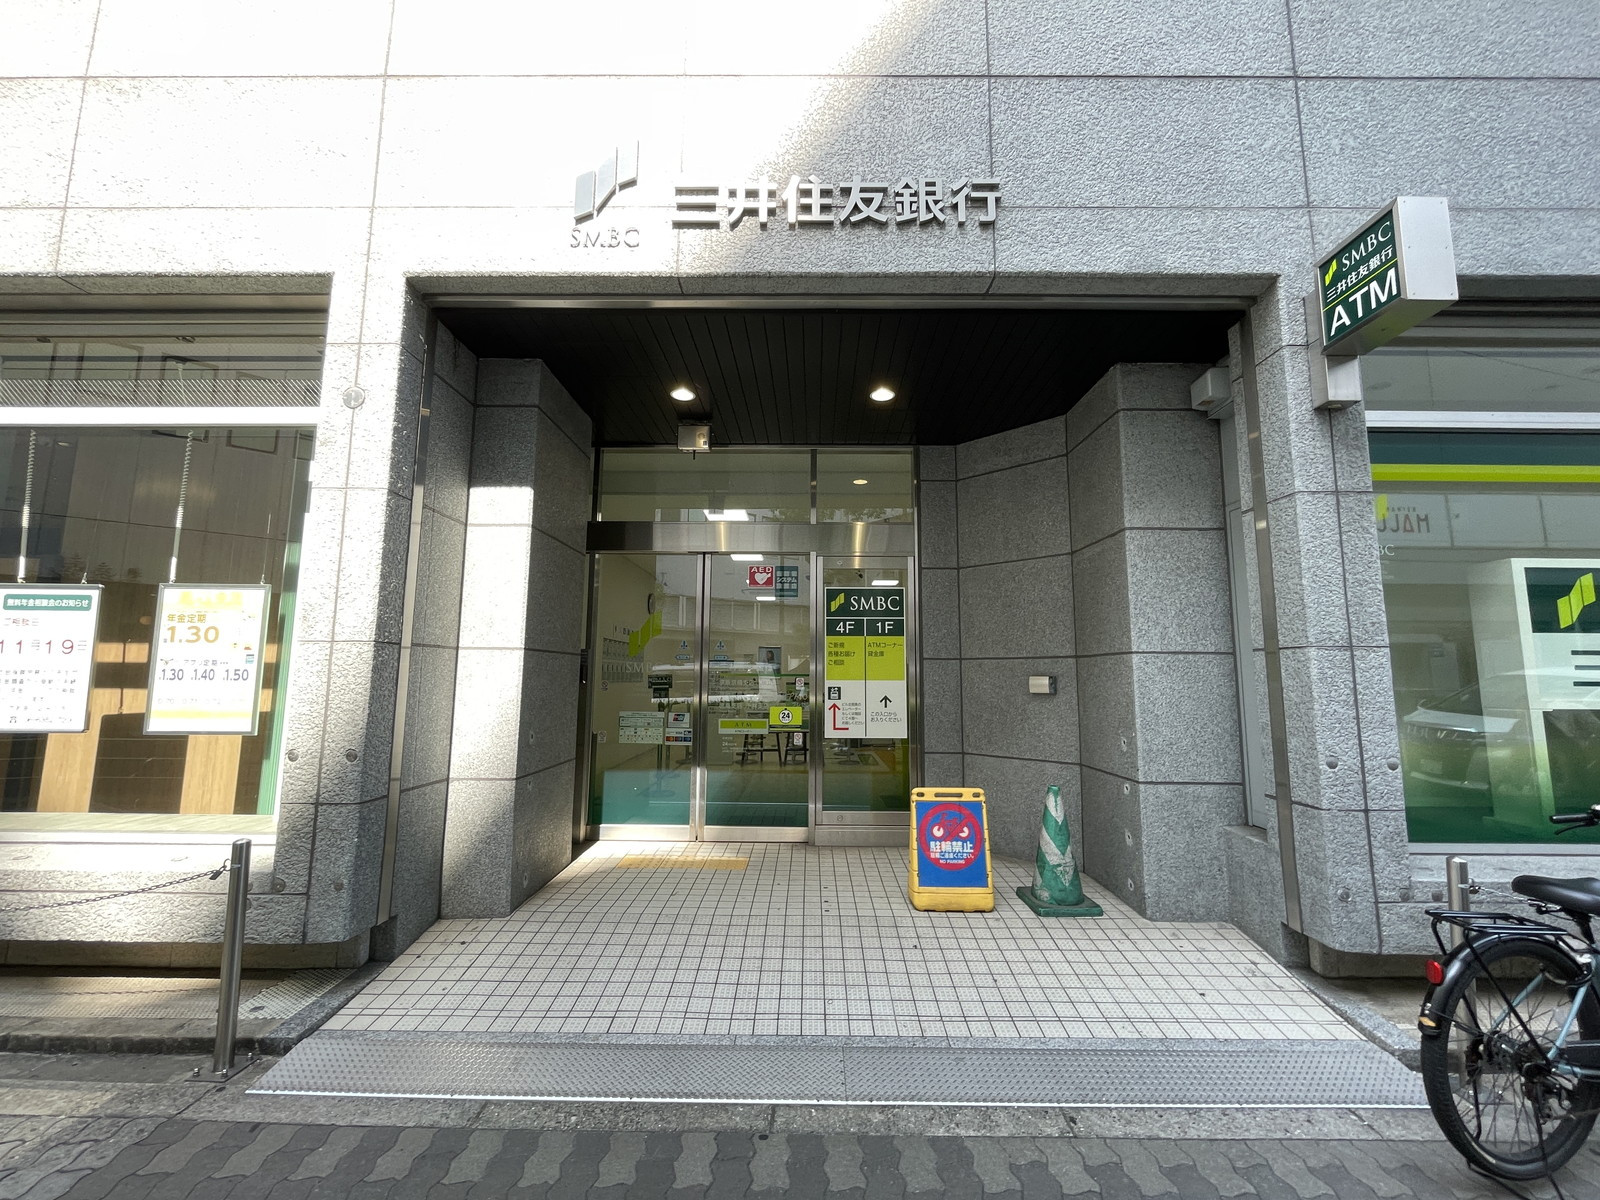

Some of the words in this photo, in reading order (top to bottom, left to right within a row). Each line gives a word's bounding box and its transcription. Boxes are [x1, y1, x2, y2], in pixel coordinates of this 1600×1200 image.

[672, 175, 1002, 229] 三井住友銀行
[570, 227, 640, 248] SMBC
[1341, 221, 1392, 272] SMBC
[1326, 244, 1393, 303] 三井住友銀行
[1330, 267, 1398, 336] ATM
[6, 598, 89, 608] 無料年金相談会のお知らせ
[850, 596, 900, 611] SMBC
[167, 613, 207, 624] 年金定期
[166, 625, 220, 644] 1.30
[835, 621, 855, 634] 4F
[876, 621, 894, 634] 1F
[160, 668, 184, 681] 1.30
[192, 668, 215, 681] 1.40
[224, 668, 249, 681] 1.50
[930, 842, 973, 852] 駐輪禁止
